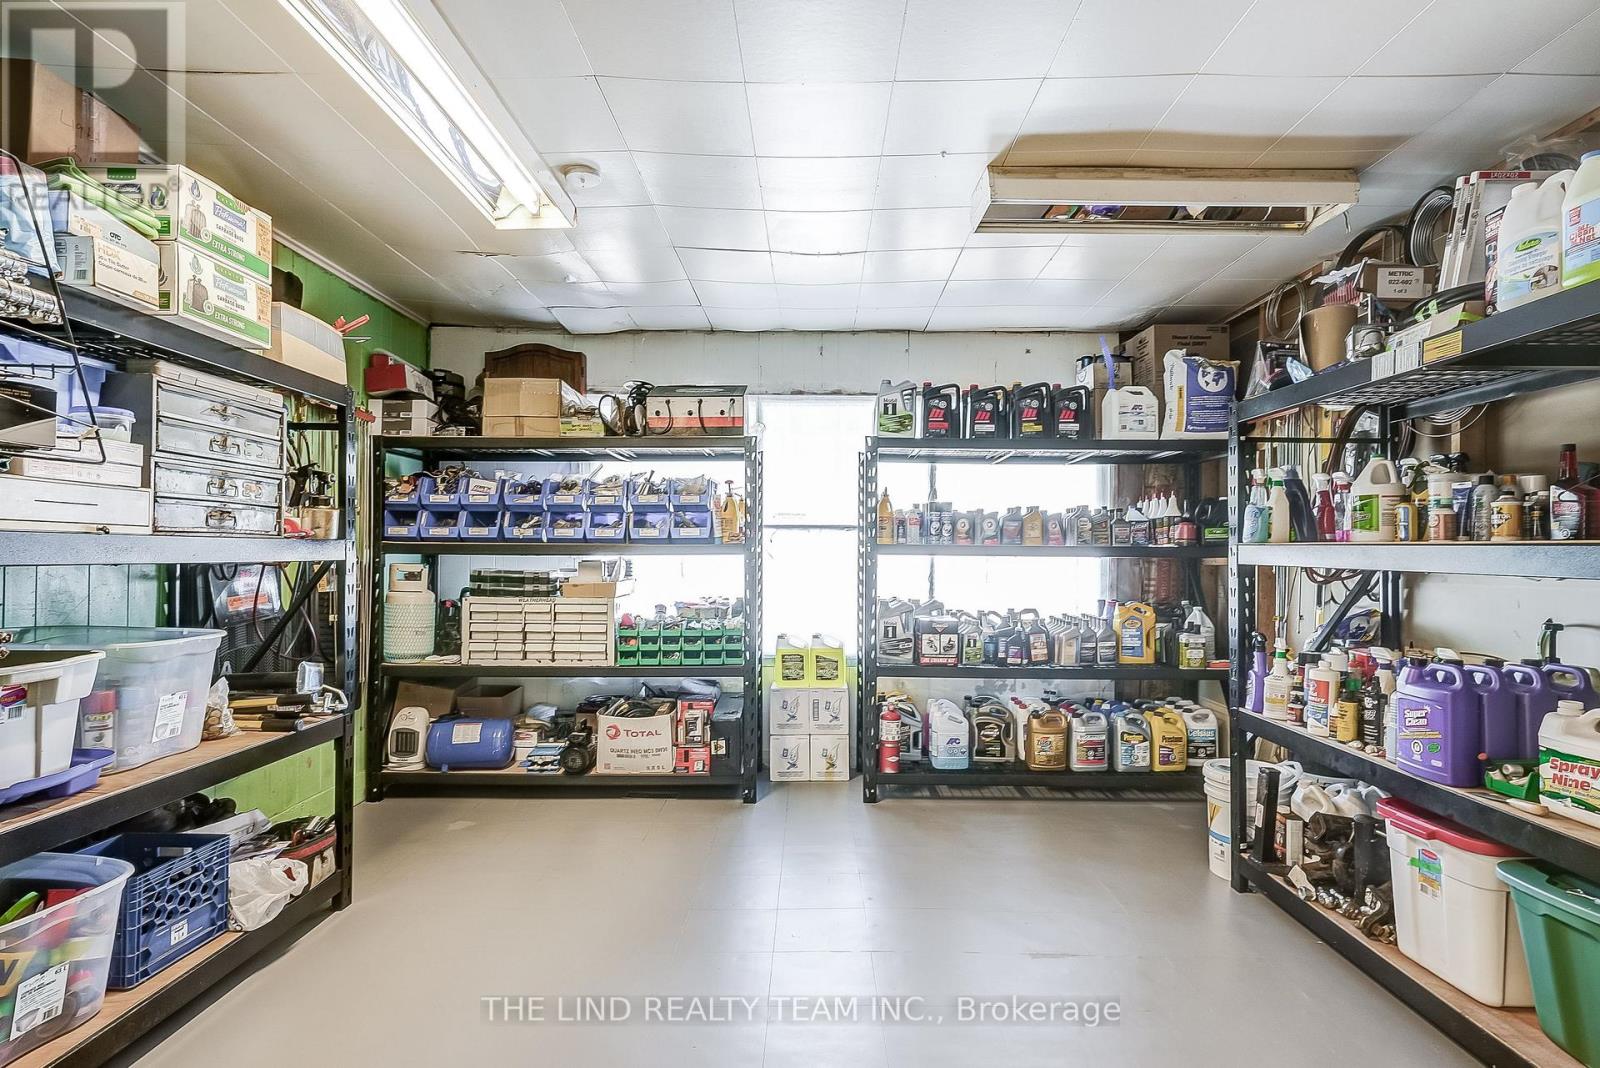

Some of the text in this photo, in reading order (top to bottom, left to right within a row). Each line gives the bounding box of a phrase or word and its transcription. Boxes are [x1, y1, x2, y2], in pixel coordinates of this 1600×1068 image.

[1404, 709, 1427, 719] Super
[1405, 718, 1428, 726] Clean
[624, 729, 662, 738] TOTAL
[1550, 758, 1600, 780] Spray
[1552, 773, 1591, 791] Nine
